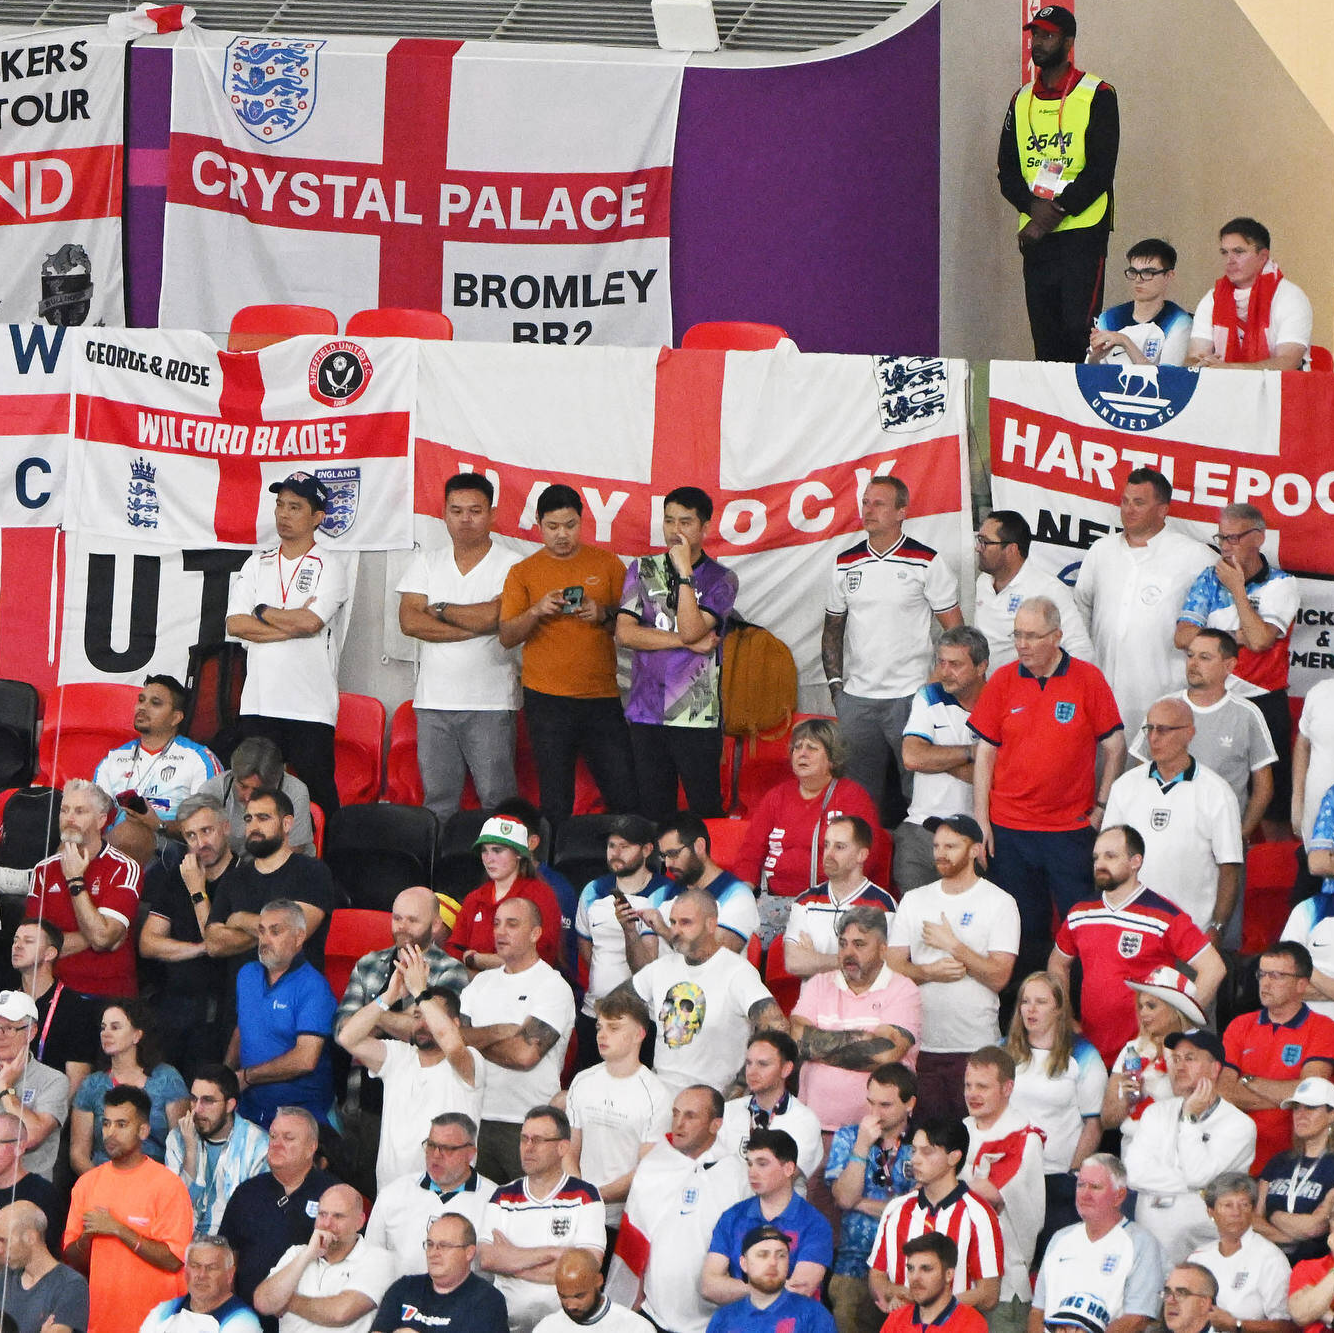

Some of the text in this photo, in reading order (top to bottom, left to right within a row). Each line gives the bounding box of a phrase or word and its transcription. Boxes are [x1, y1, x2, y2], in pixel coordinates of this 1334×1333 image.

[1026, 132, 1072, 151] 3544
[191, 150, 647, 230] CRYSTAL PALACE
[452, 269, 658, 309] BROMLEY
[9, 324, 67, 374] W
[86, 340, 210, 387] GEORGE & ROSE
[309, 344, 336, 385] SHEFFIELD
[338, 342, 366, 361] UNITED
[137, 411, 346, 457] WILFORD BLADES
[1092, 396, 1175, 429] UNITED FC
[15, 457, 52, 509] C
[317, 469, 357, 478] ENGLAND
[1316, 630, 1330, 647] &
